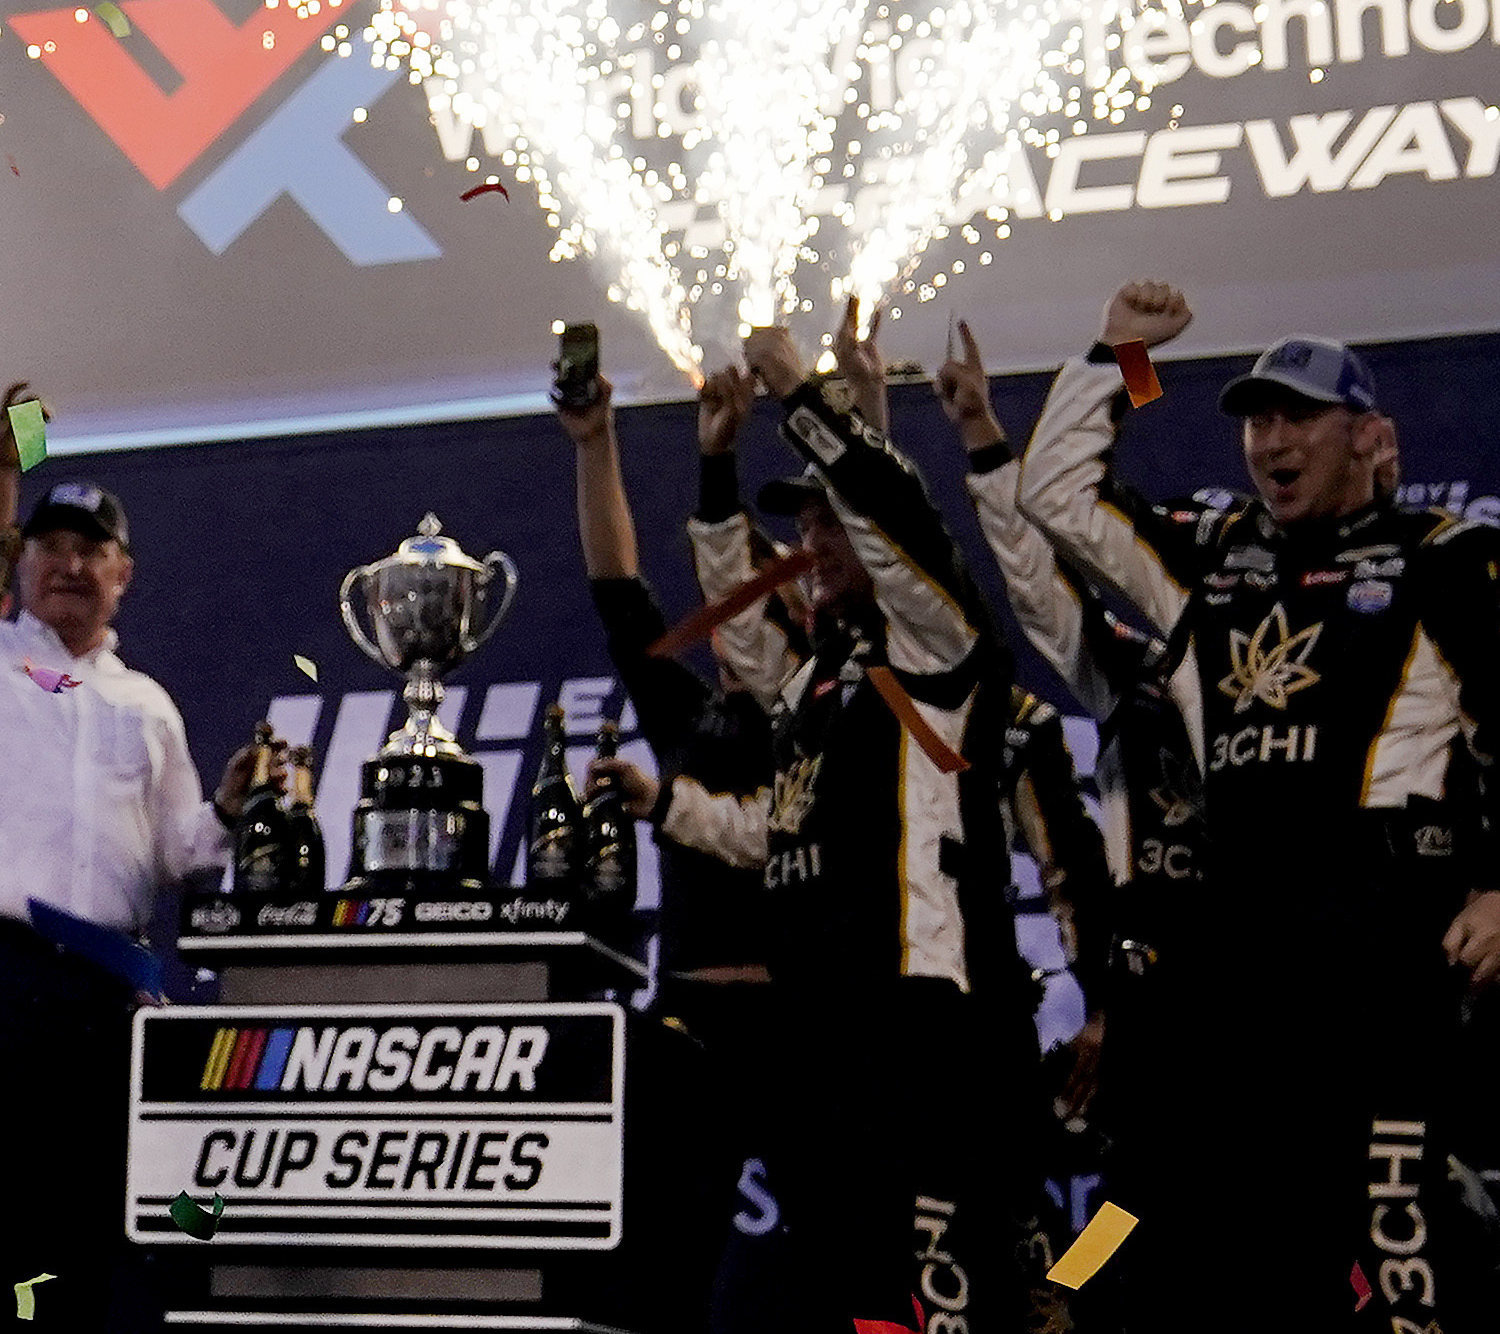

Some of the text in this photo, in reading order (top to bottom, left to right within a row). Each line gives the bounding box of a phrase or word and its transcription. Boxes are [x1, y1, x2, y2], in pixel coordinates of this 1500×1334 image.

[762, 841, 822, 892] CHI
[278, 1025, 551, 1094] NASCAR
[192, 1130, 551, 1192] CUP SERIES
[1367, 1118, 1437, 1308] 3CHI
